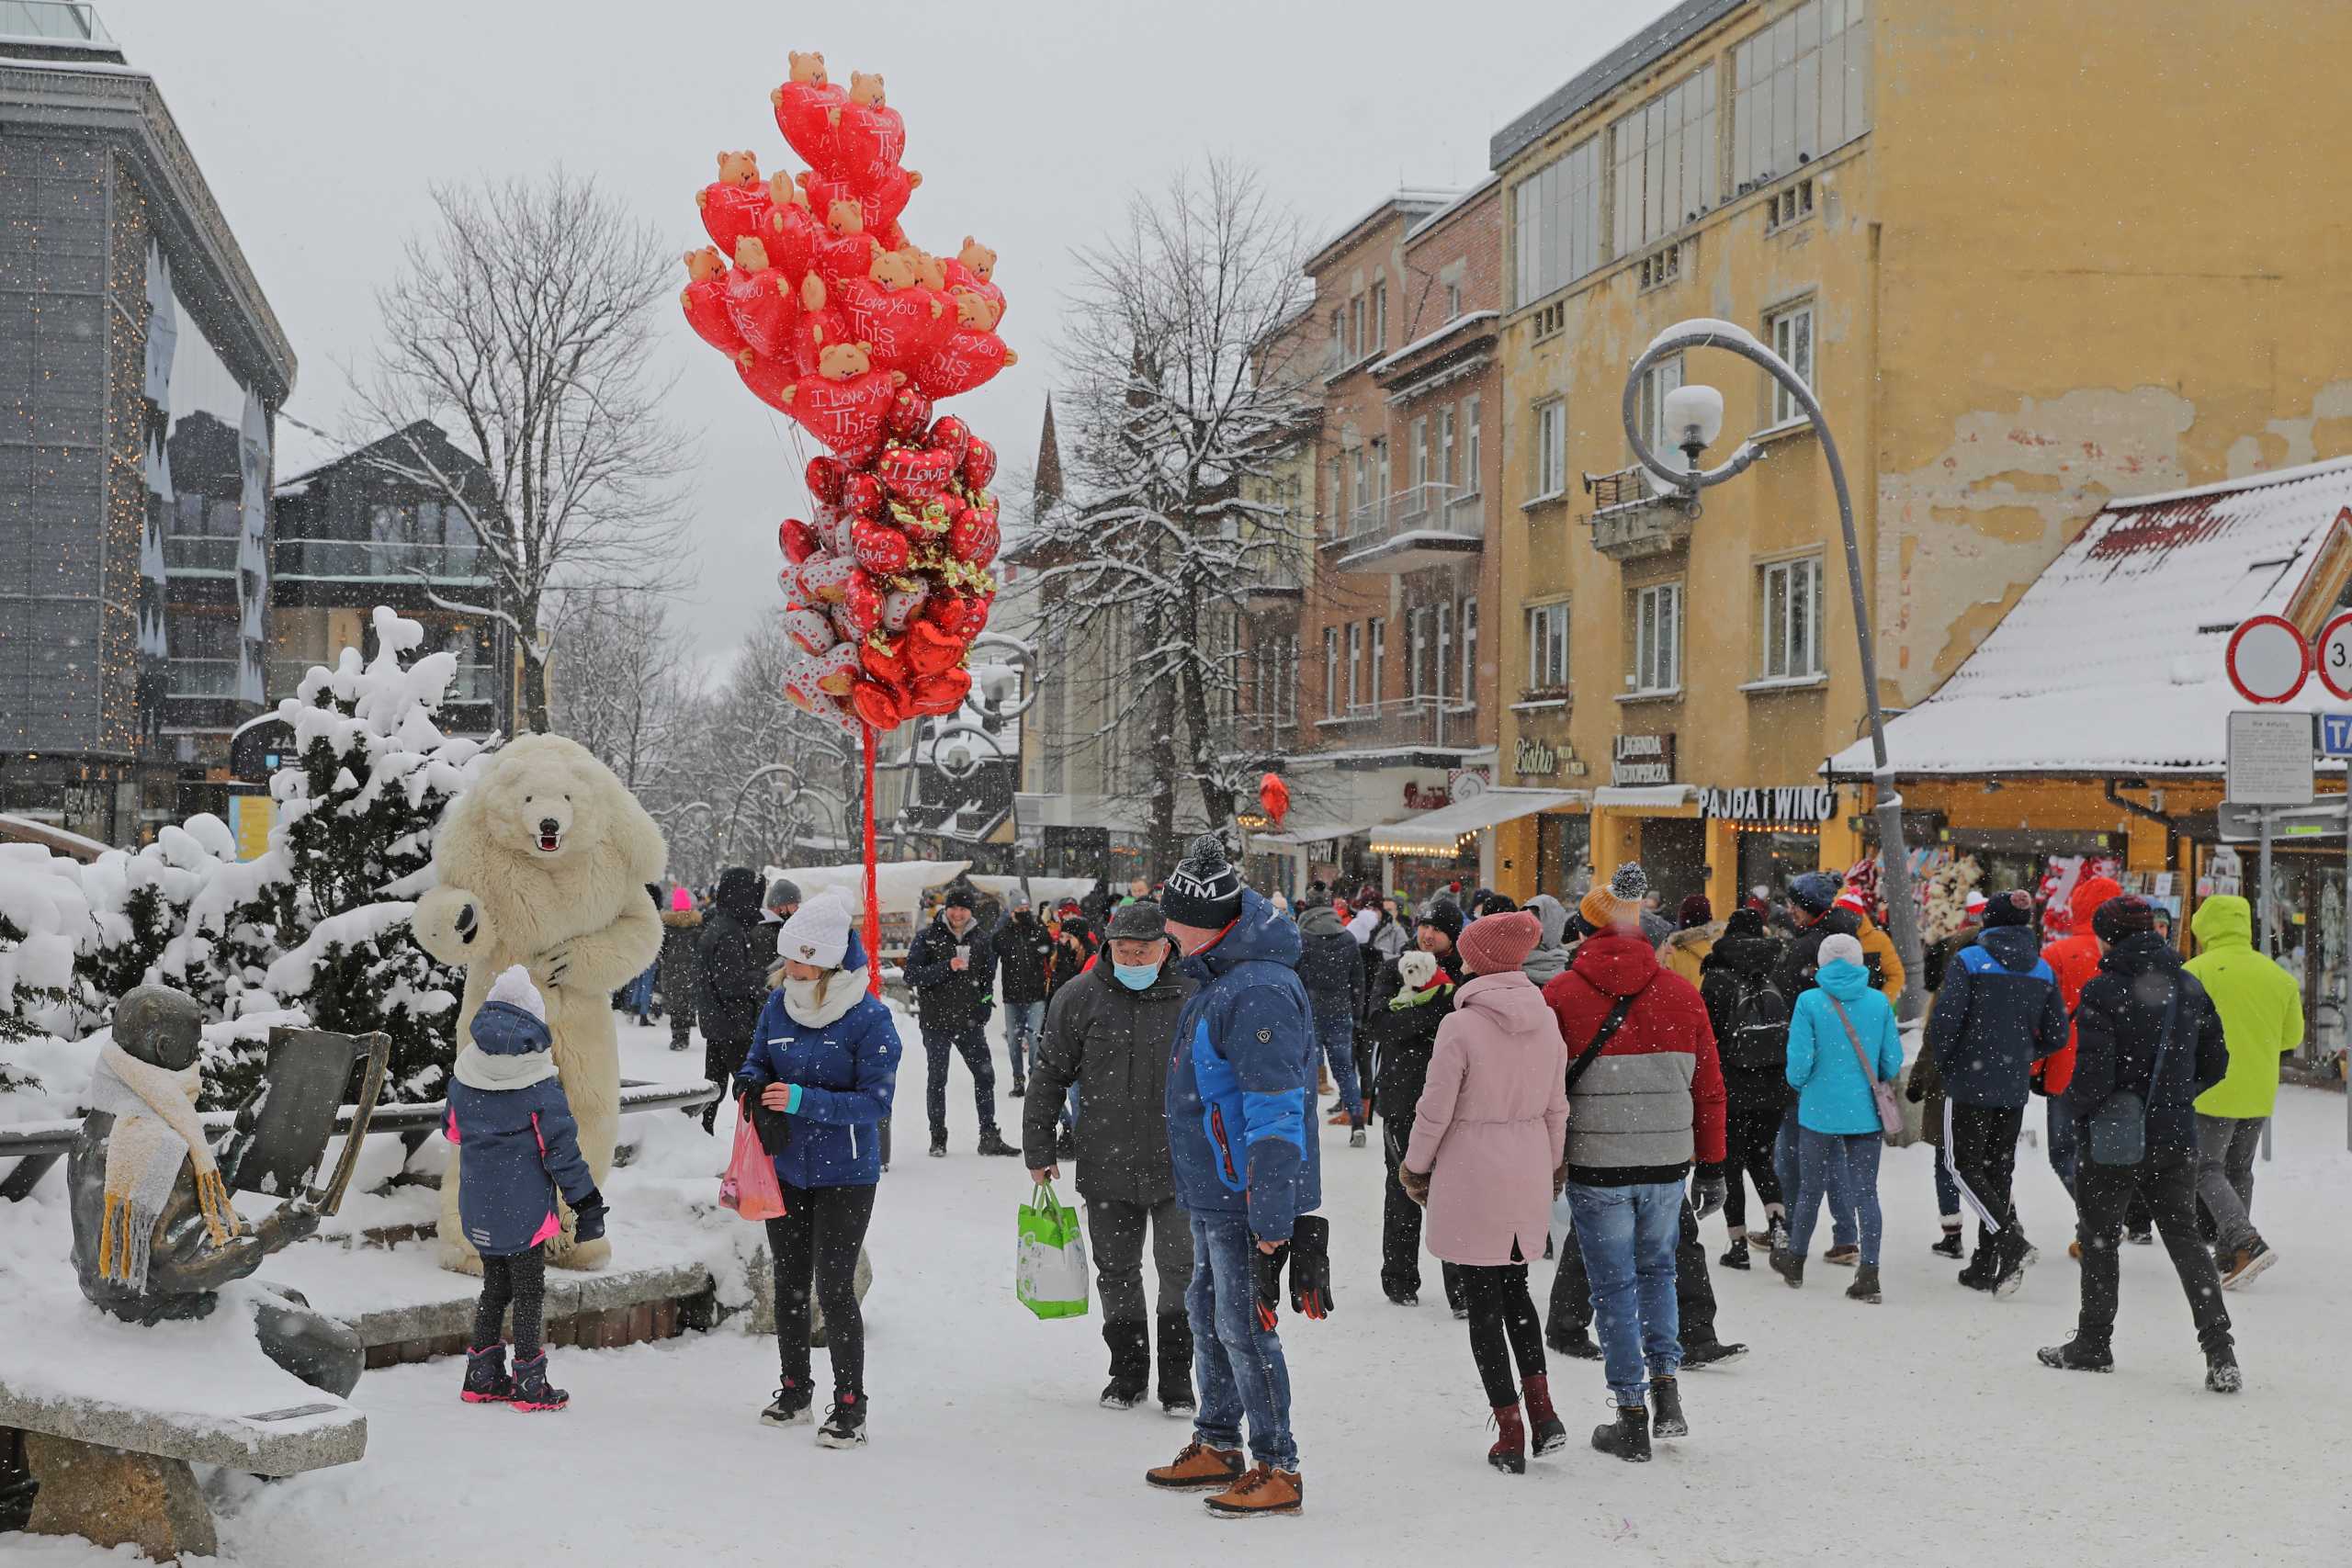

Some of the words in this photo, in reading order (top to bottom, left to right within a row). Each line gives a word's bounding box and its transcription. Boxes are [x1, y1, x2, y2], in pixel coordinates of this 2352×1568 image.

[844, 285, 858, 303] I
[855, 288, 888, 310] Love
[886, 298, 918, 318] You
[848, 307, 896, 344] This
[873, 343, 898, 358] ch!
[967, 335, 1000, 357] You
[931, 350, 972, 378] his
[811, 389, 827, 408] I
[830, 389, 866, 407] Love
[866, 381, 892, 405] You
[822, 407, 878, 434] This
[891, 462, 903, 480] I
[1697, 786, 1758, 819] PAJDA
